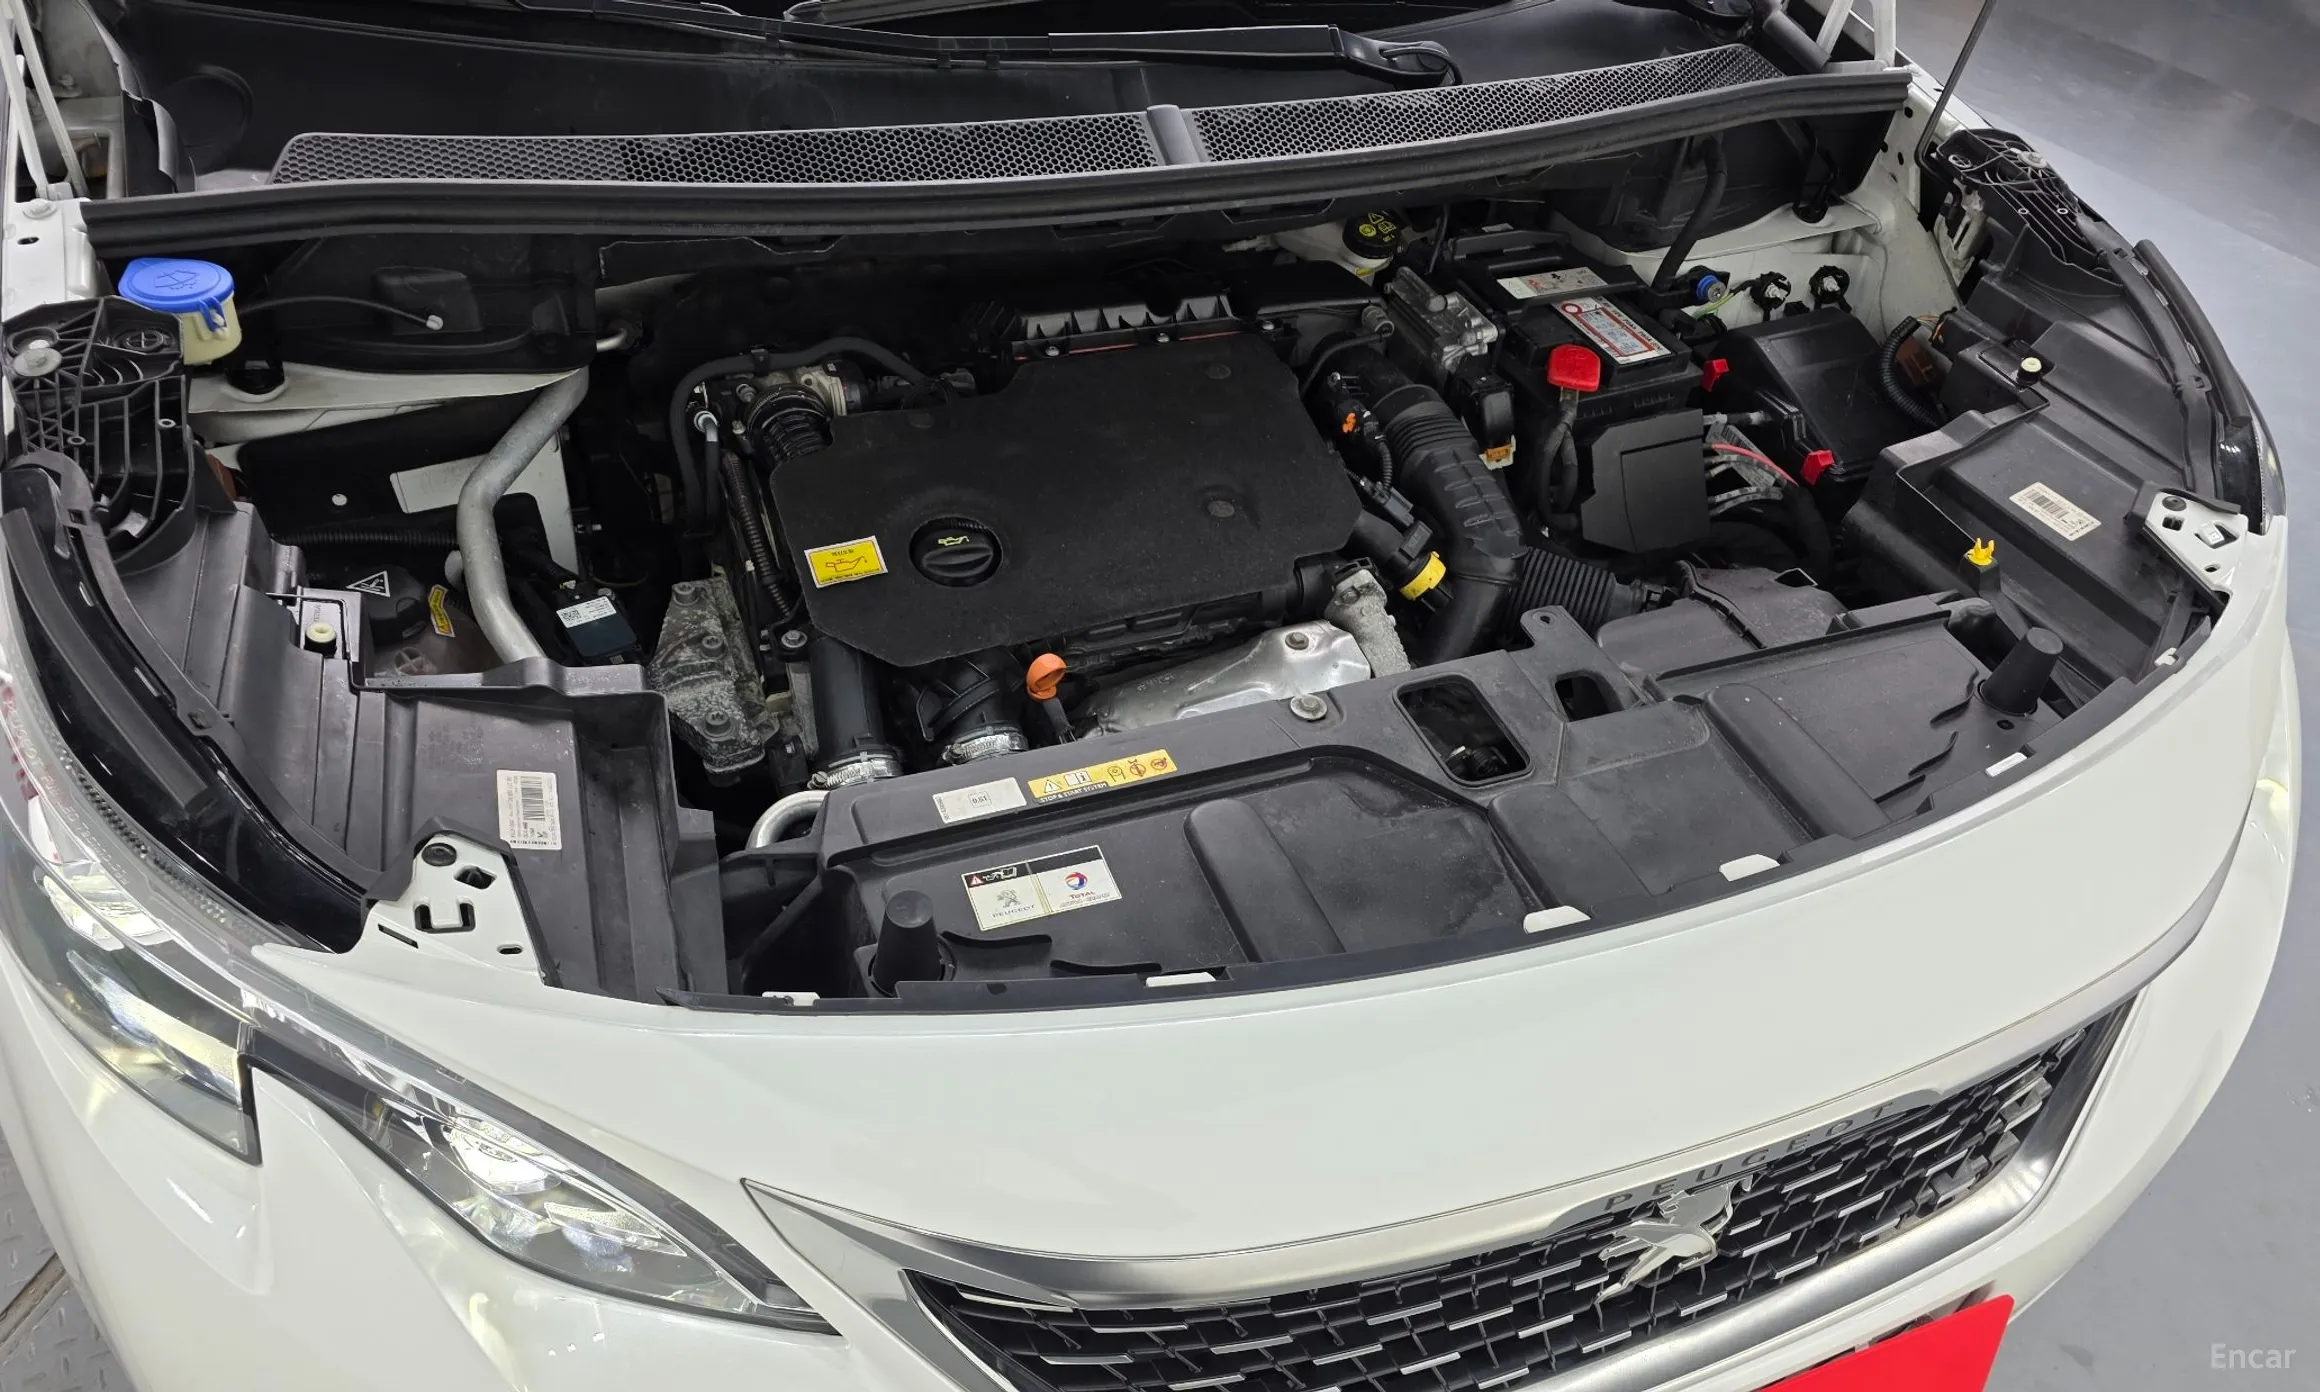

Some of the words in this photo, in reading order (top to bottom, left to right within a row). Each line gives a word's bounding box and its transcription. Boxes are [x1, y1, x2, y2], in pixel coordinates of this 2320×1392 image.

[1069, 890, 1095, 899] TOTAL
[992, 904, 1035, 918] PEUGEOT
[1603, 1102, 1894, 1212] PEUGEOT
